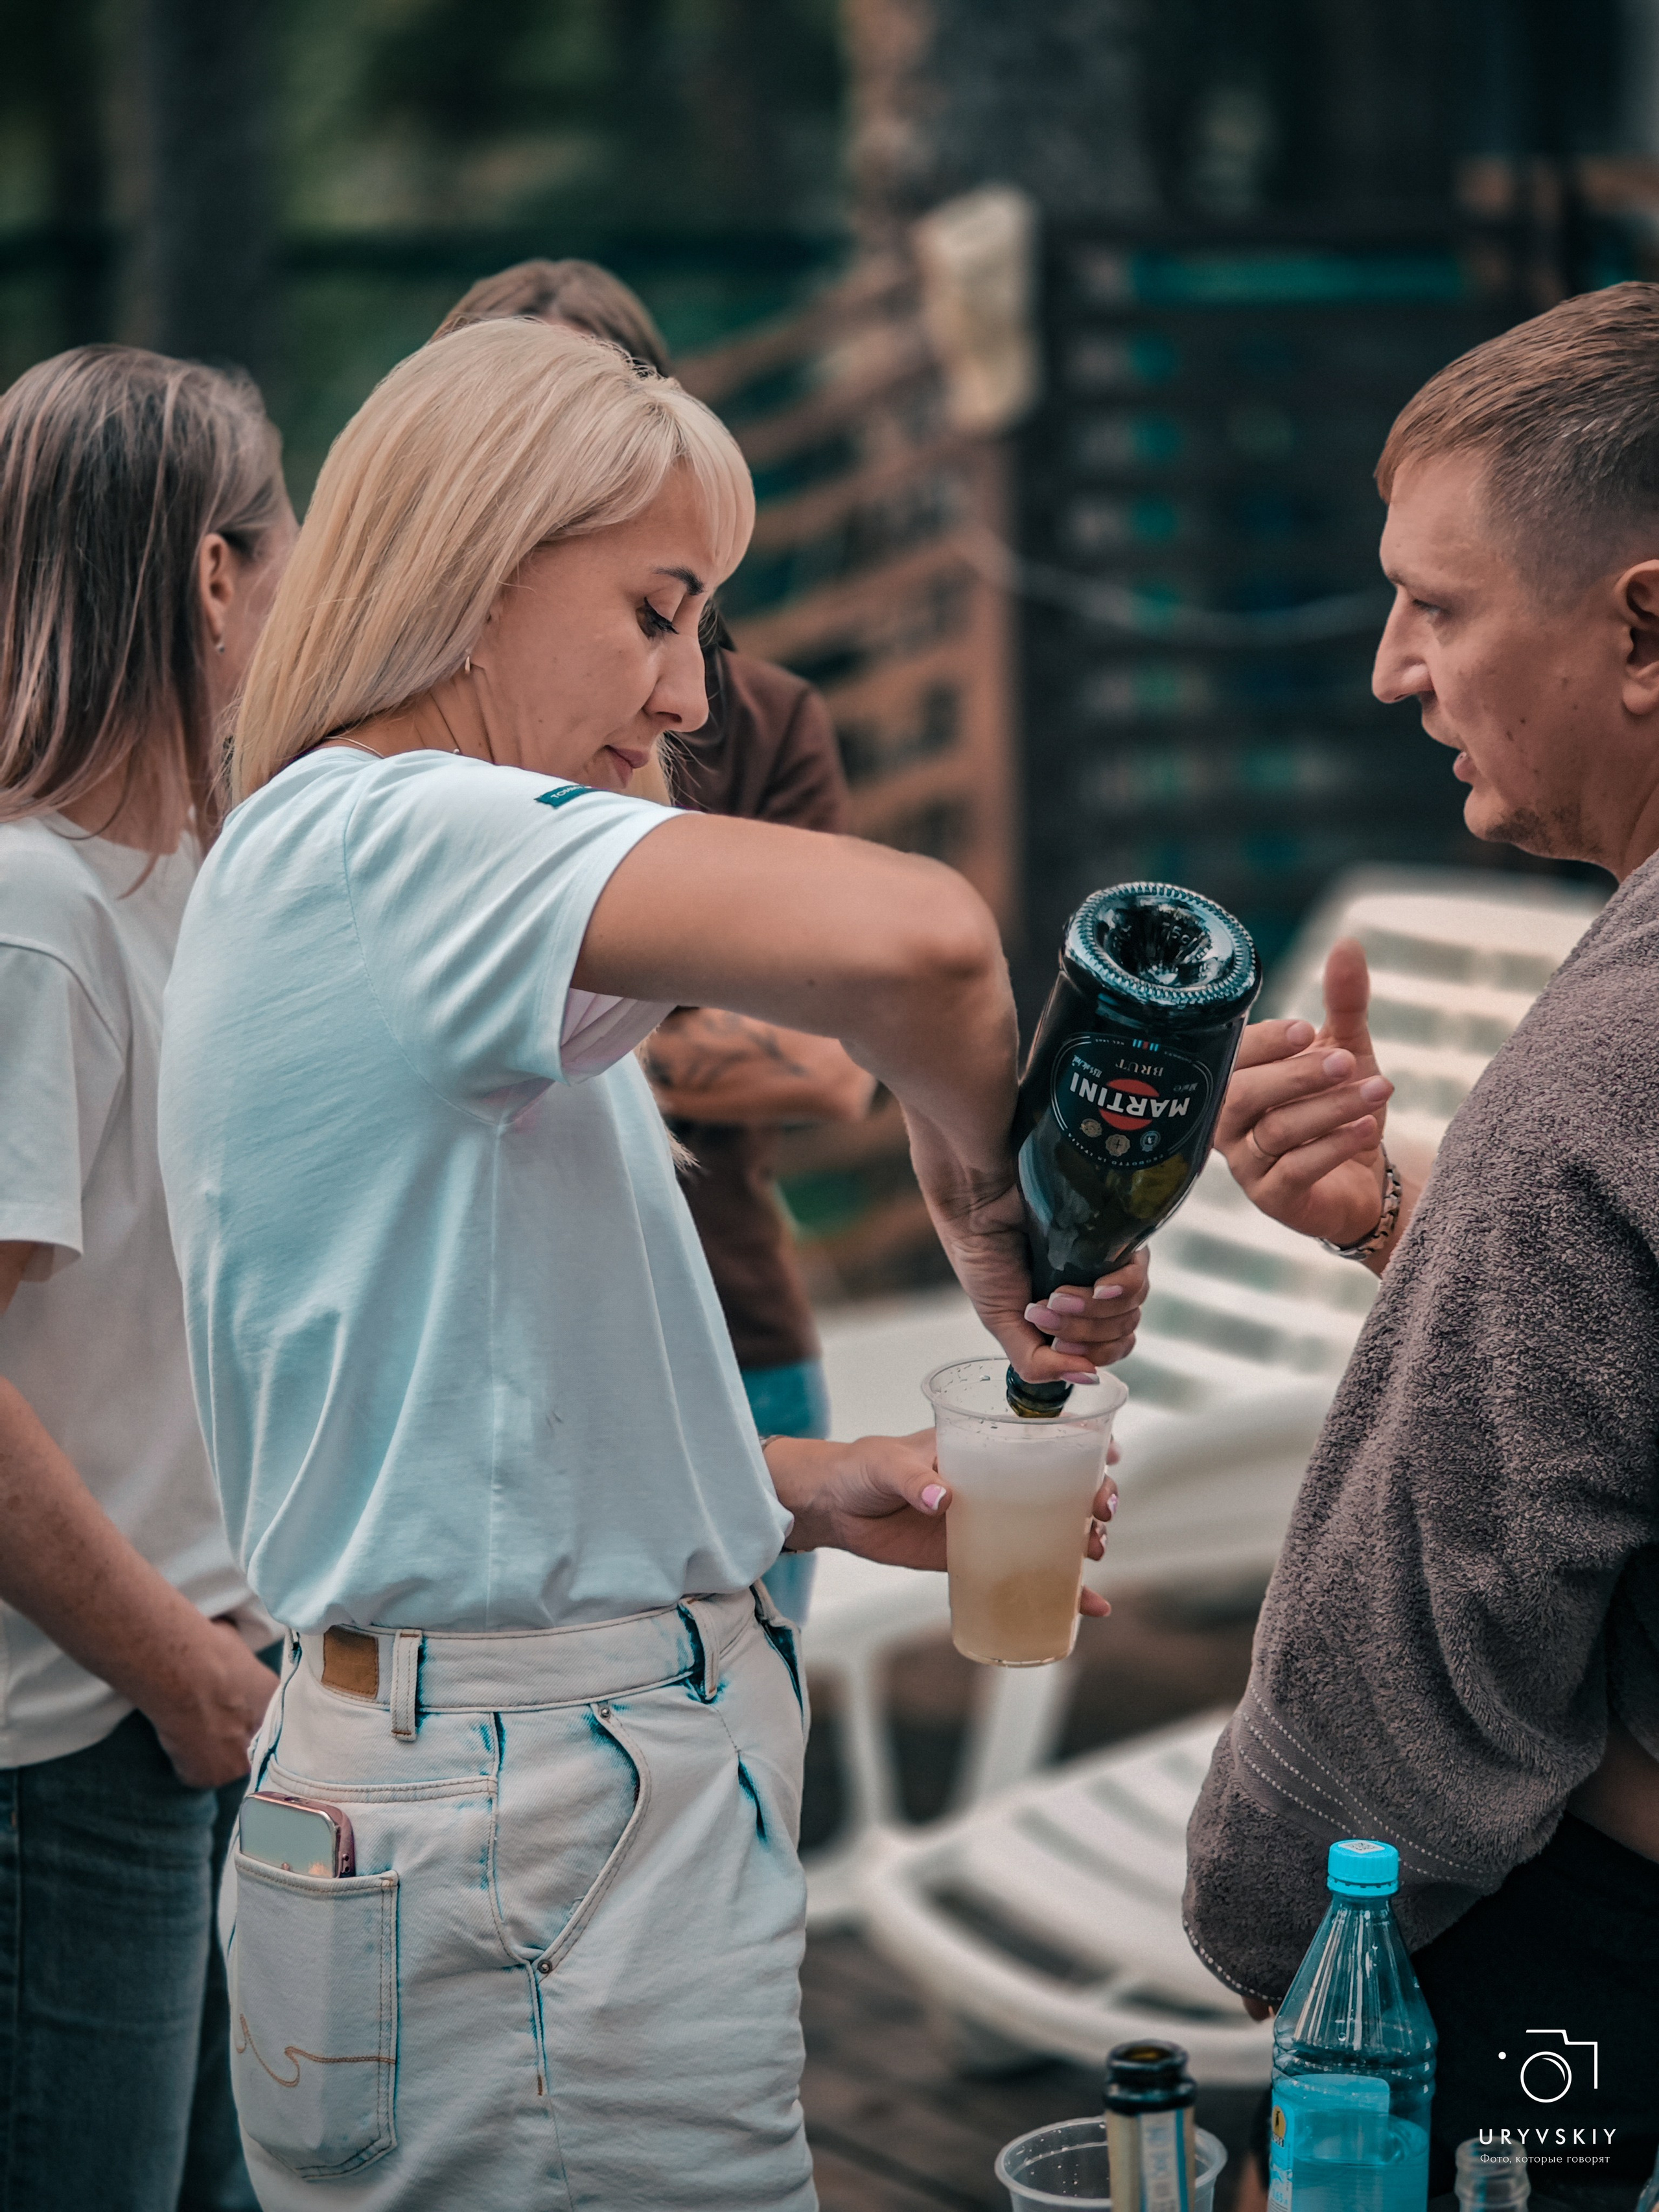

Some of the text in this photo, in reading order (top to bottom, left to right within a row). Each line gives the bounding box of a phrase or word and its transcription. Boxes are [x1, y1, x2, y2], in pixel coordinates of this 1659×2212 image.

[550, 786, 583, 798] TOMMY
[1115, 1058, 1164, 1077] BRUT
[1070, 1072, 1190, 1118] MARTINI
